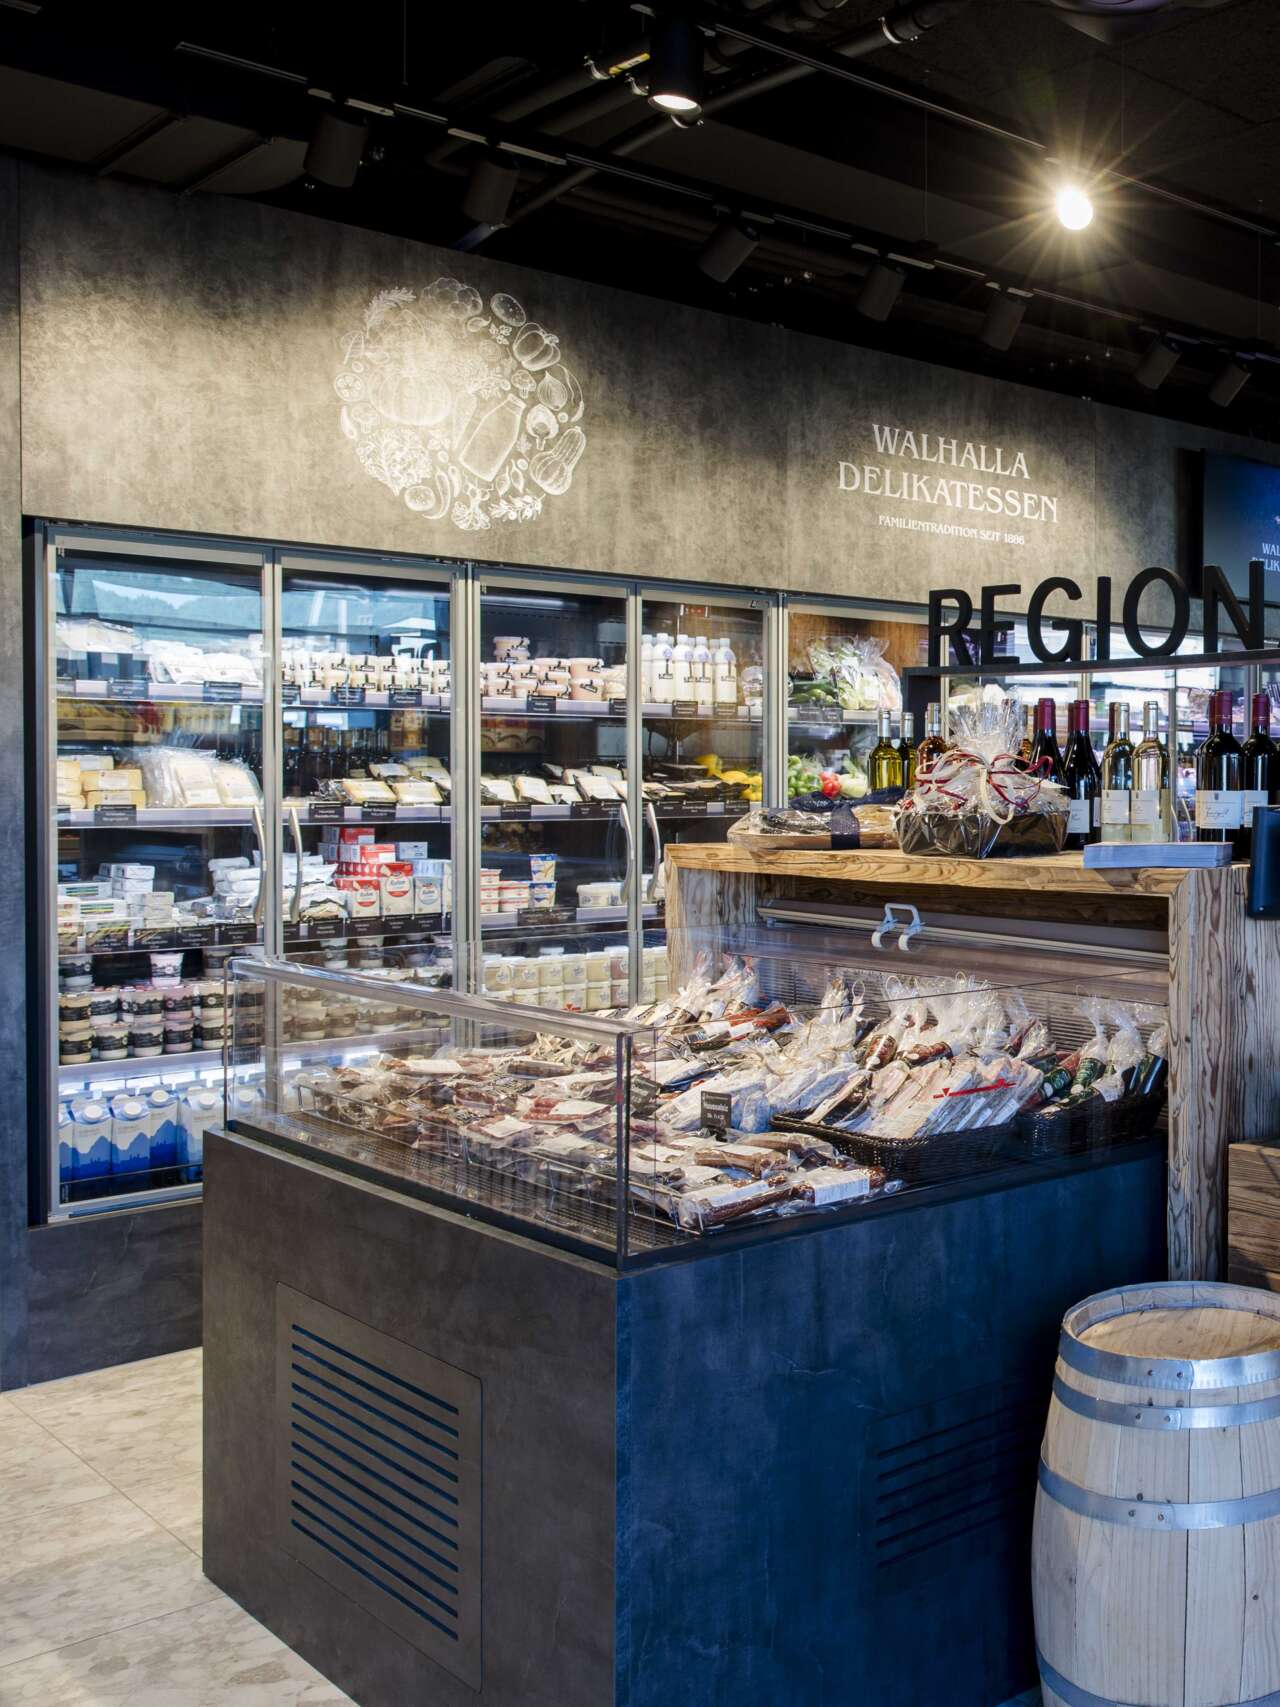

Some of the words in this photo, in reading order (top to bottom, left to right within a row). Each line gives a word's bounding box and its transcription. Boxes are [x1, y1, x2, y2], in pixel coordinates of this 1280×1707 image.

[872, 424, 1030, 479] WALHALLA
[838, 461, 1058, 523] DELIKATESSEN
[879, 515, 977, 539] FAMILIENTRADITION
[980, 530, 1001, 542] SEIT
